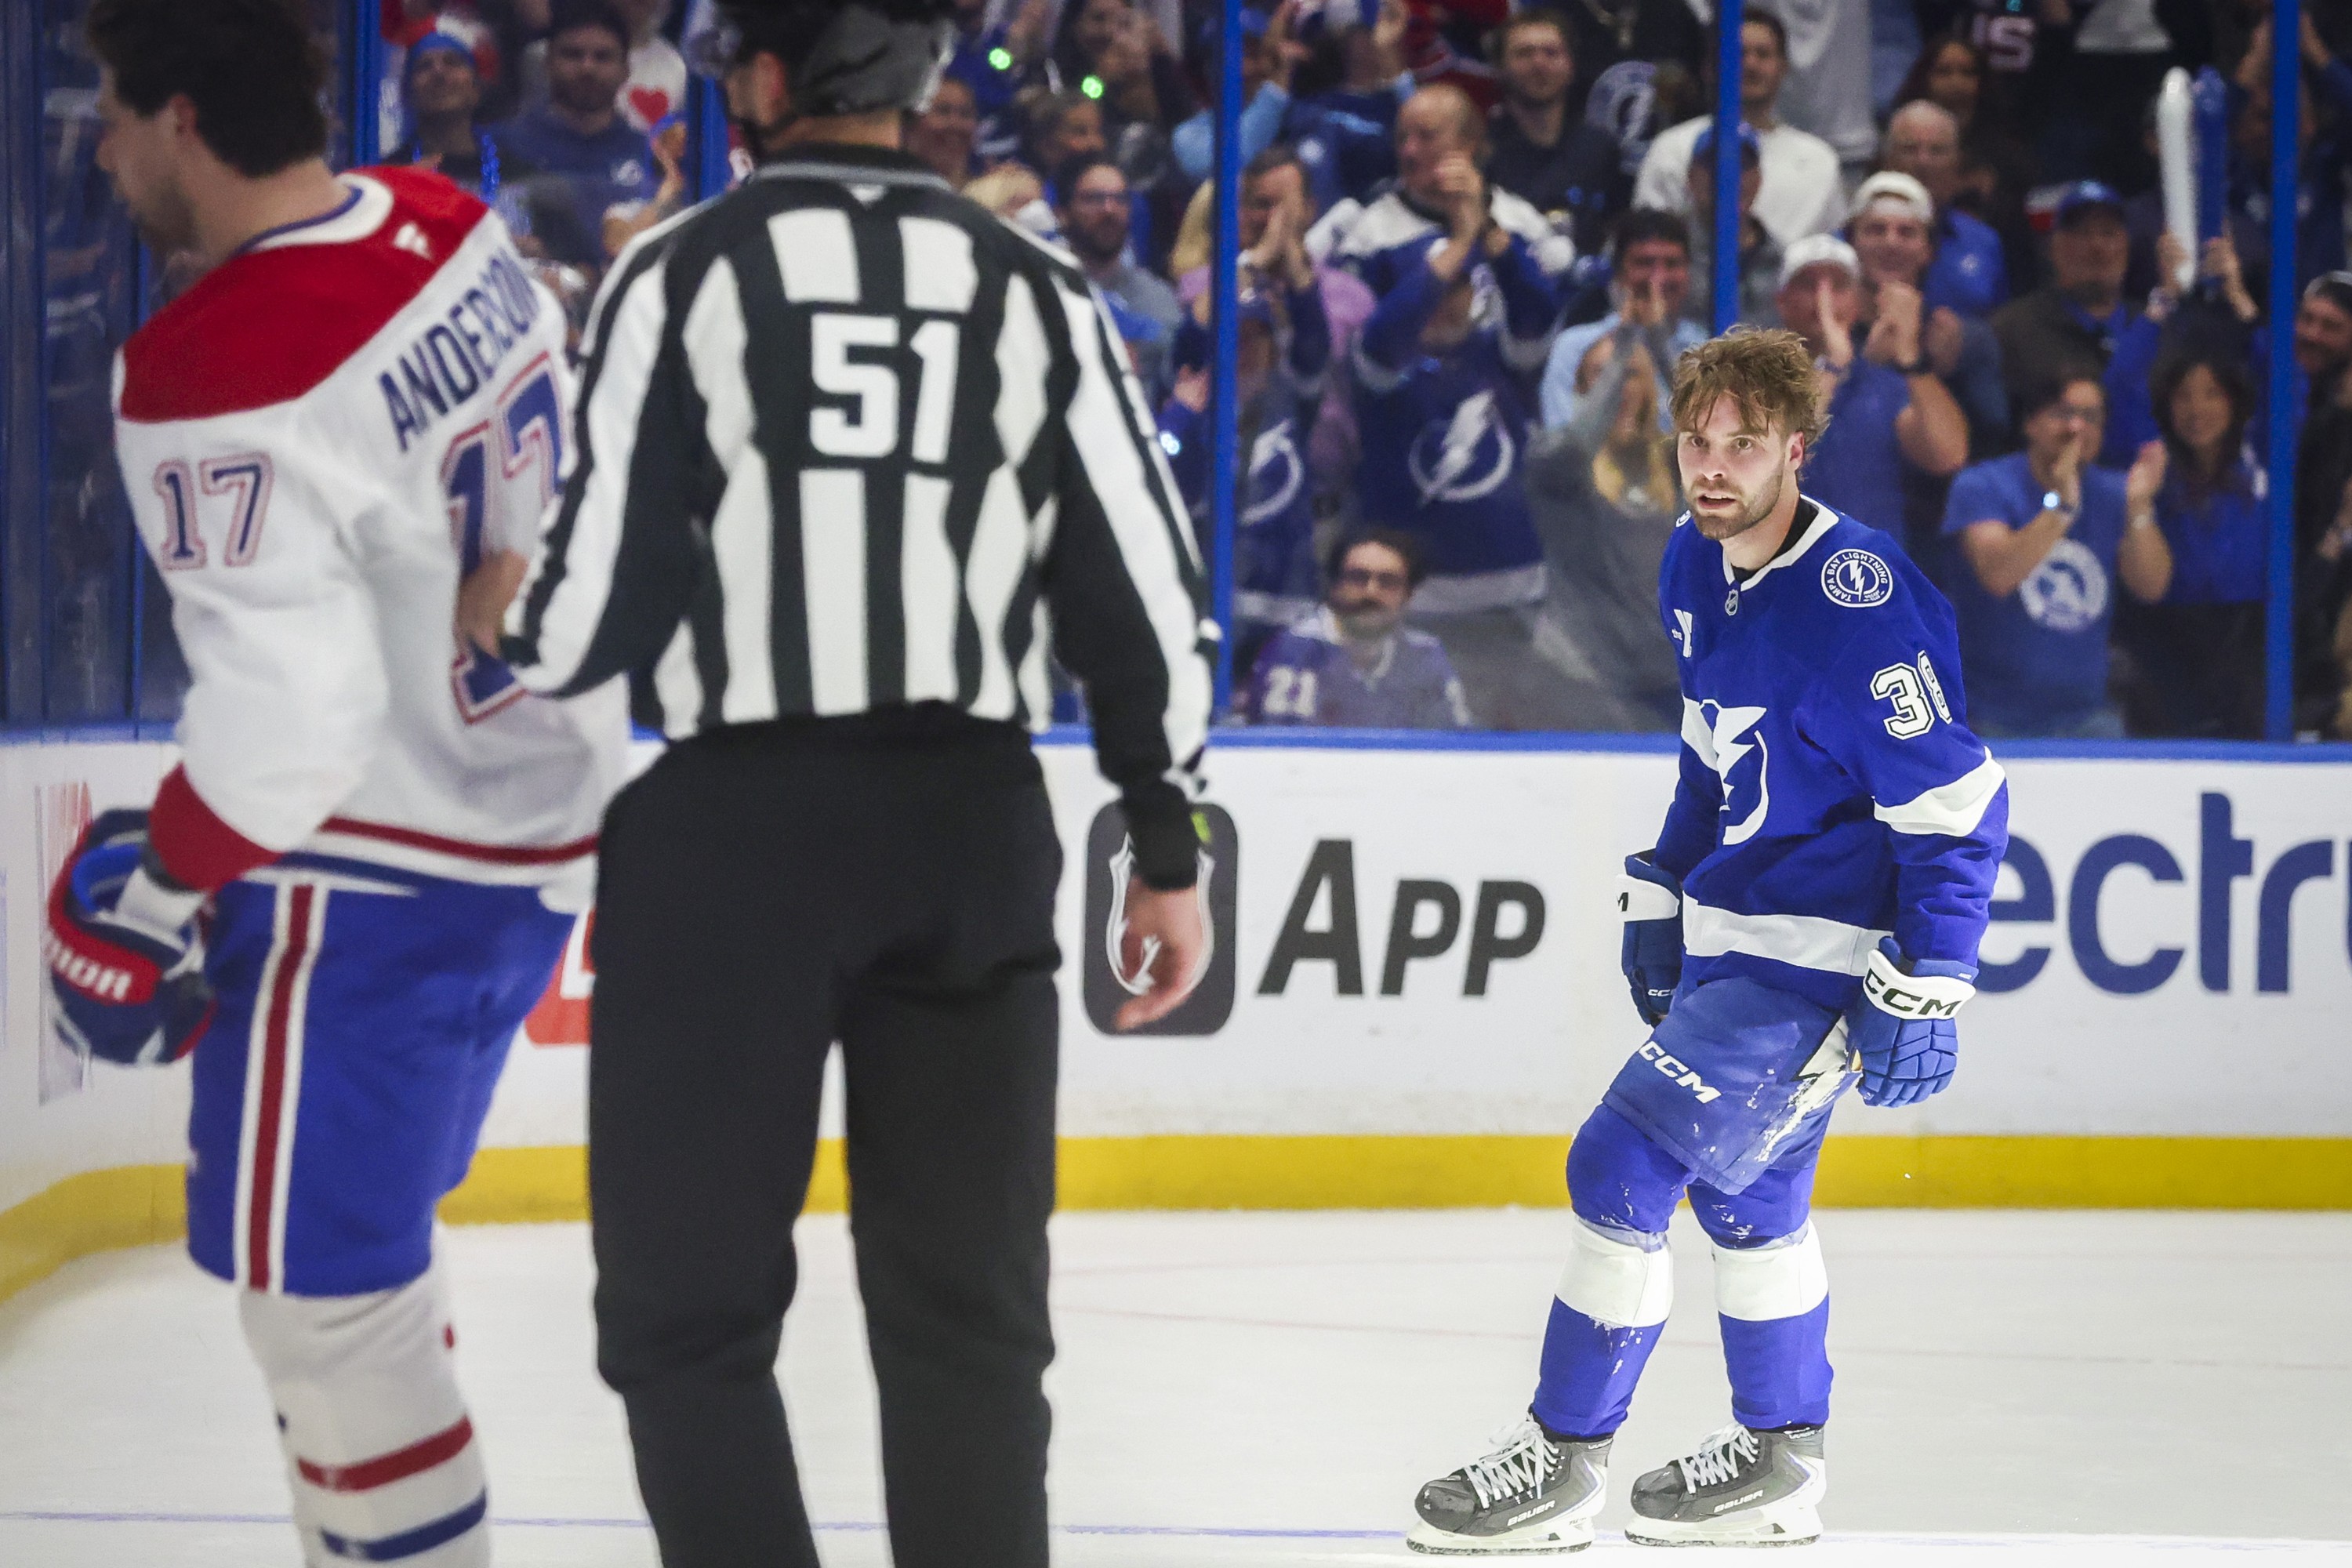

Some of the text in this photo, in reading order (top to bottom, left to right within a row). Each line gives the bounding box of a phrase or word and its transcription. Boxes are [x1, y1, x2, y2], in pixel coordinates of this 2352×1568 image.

[809, 314, 960, 463] 51
[152, 451, 275, 570] 17
[1826, 557, 1841, 575] BAY
[1827, 577, 1852, 602] TAMPA
[1842, 552, 1888, 584] LIGHTNING
[1264, 666, 1319, 717] 21
[1869, 649, 1953, 740] 38
[1976, 791, 2352, 994] ectr
[1647, 989, 1675, 997] CC
[1865, 967, 1963, 1016] CCM
[1639, 1041, 1722, 1104] CCM
